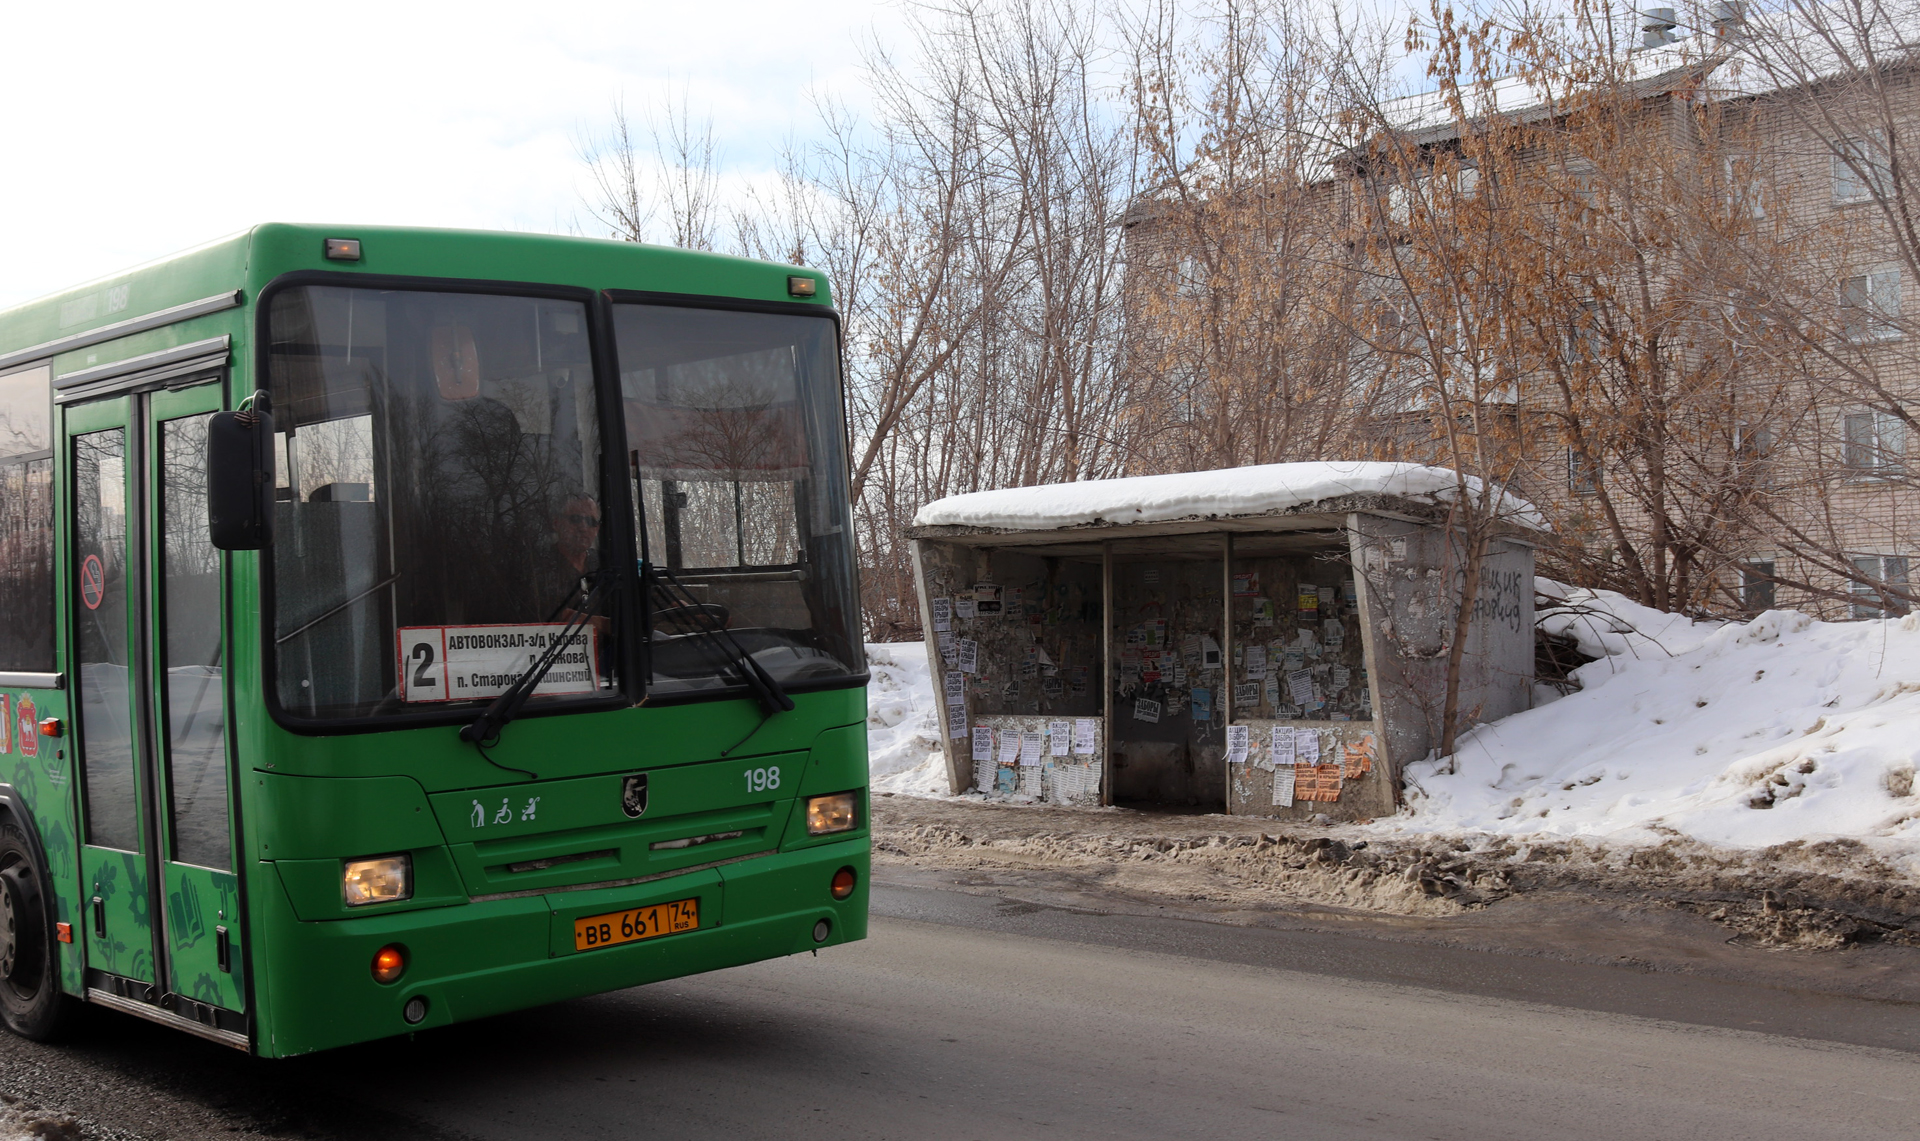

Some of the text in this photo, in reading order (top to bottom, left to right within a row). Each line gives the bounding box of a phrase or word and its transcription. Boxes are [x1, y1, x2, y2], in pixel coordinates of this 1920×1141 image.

[107, 285, 129, 313] 198
[449, 633, 546, 650] АВТОВОКЗАЛ-з/д
[412, 643, 436, 687] 2
[457, 676, 468, 688] п.
[1235, 684, 1258, 696] ЗАБОРЫ
[1137, 698, 1159, 713] ЗАБОРЫ
[744, 766, 780, 792] 198
[586, 902, 690, 945] ВВ 661 74
[674, 921, 689, 930] RUS
